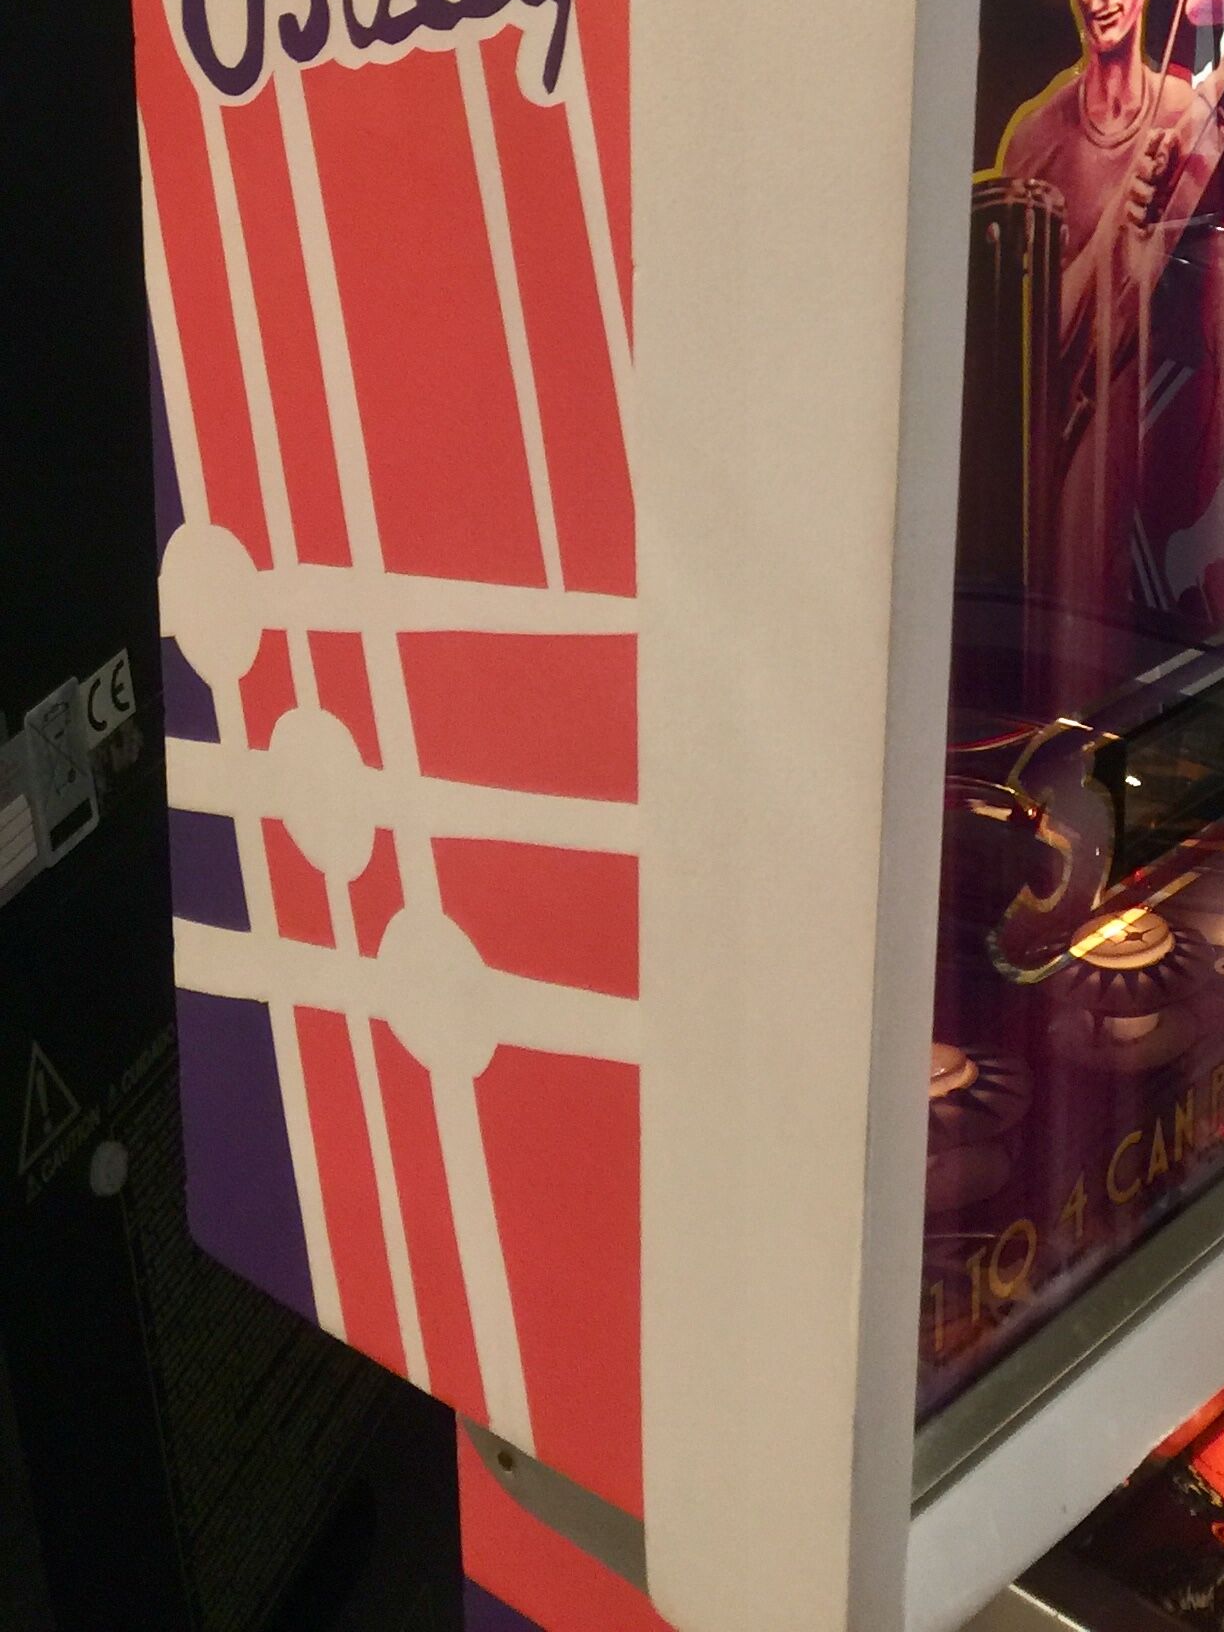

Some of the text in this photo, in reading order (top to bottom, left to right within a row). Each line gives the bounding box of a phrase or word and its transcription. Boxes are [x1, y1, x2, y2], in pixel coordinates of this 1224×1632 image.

[965, 1218, 1038, 1325] TO
[1060, 1172, 1088, 1238] 4
[1106, 1086, 1198, 1205] CAN
